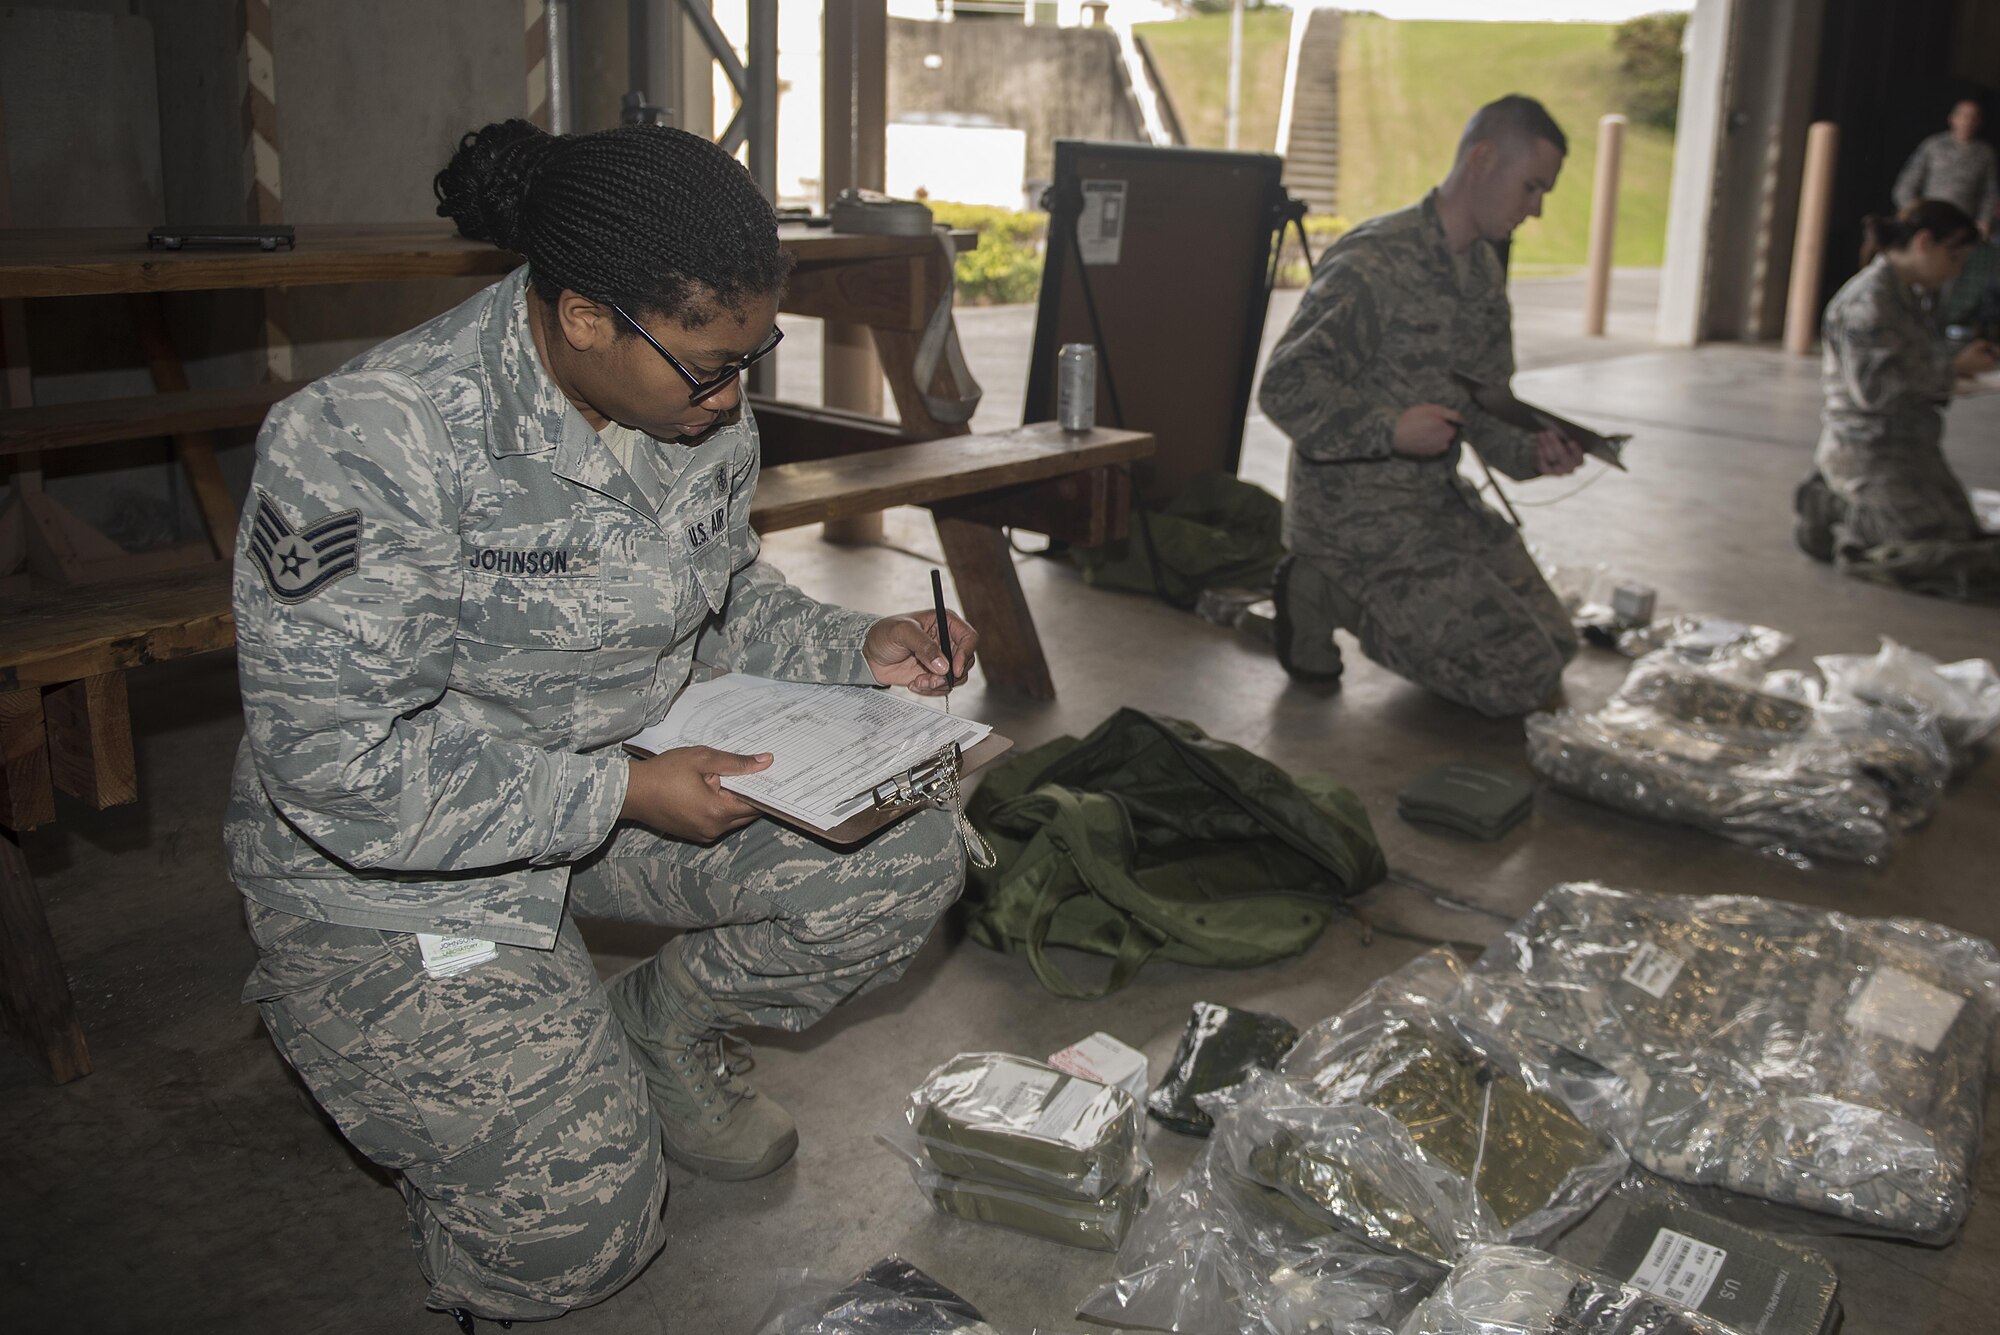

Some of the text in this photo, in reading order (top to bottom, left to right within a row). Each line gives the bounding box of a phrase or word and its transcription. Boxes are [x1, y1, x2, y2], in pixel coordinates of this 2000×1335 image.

[688, 508, 725, 547] U.S. AIR
[469, 548, 567, 574] JOHNSON
[1718, 1278, 1741, 1300] U.S.
